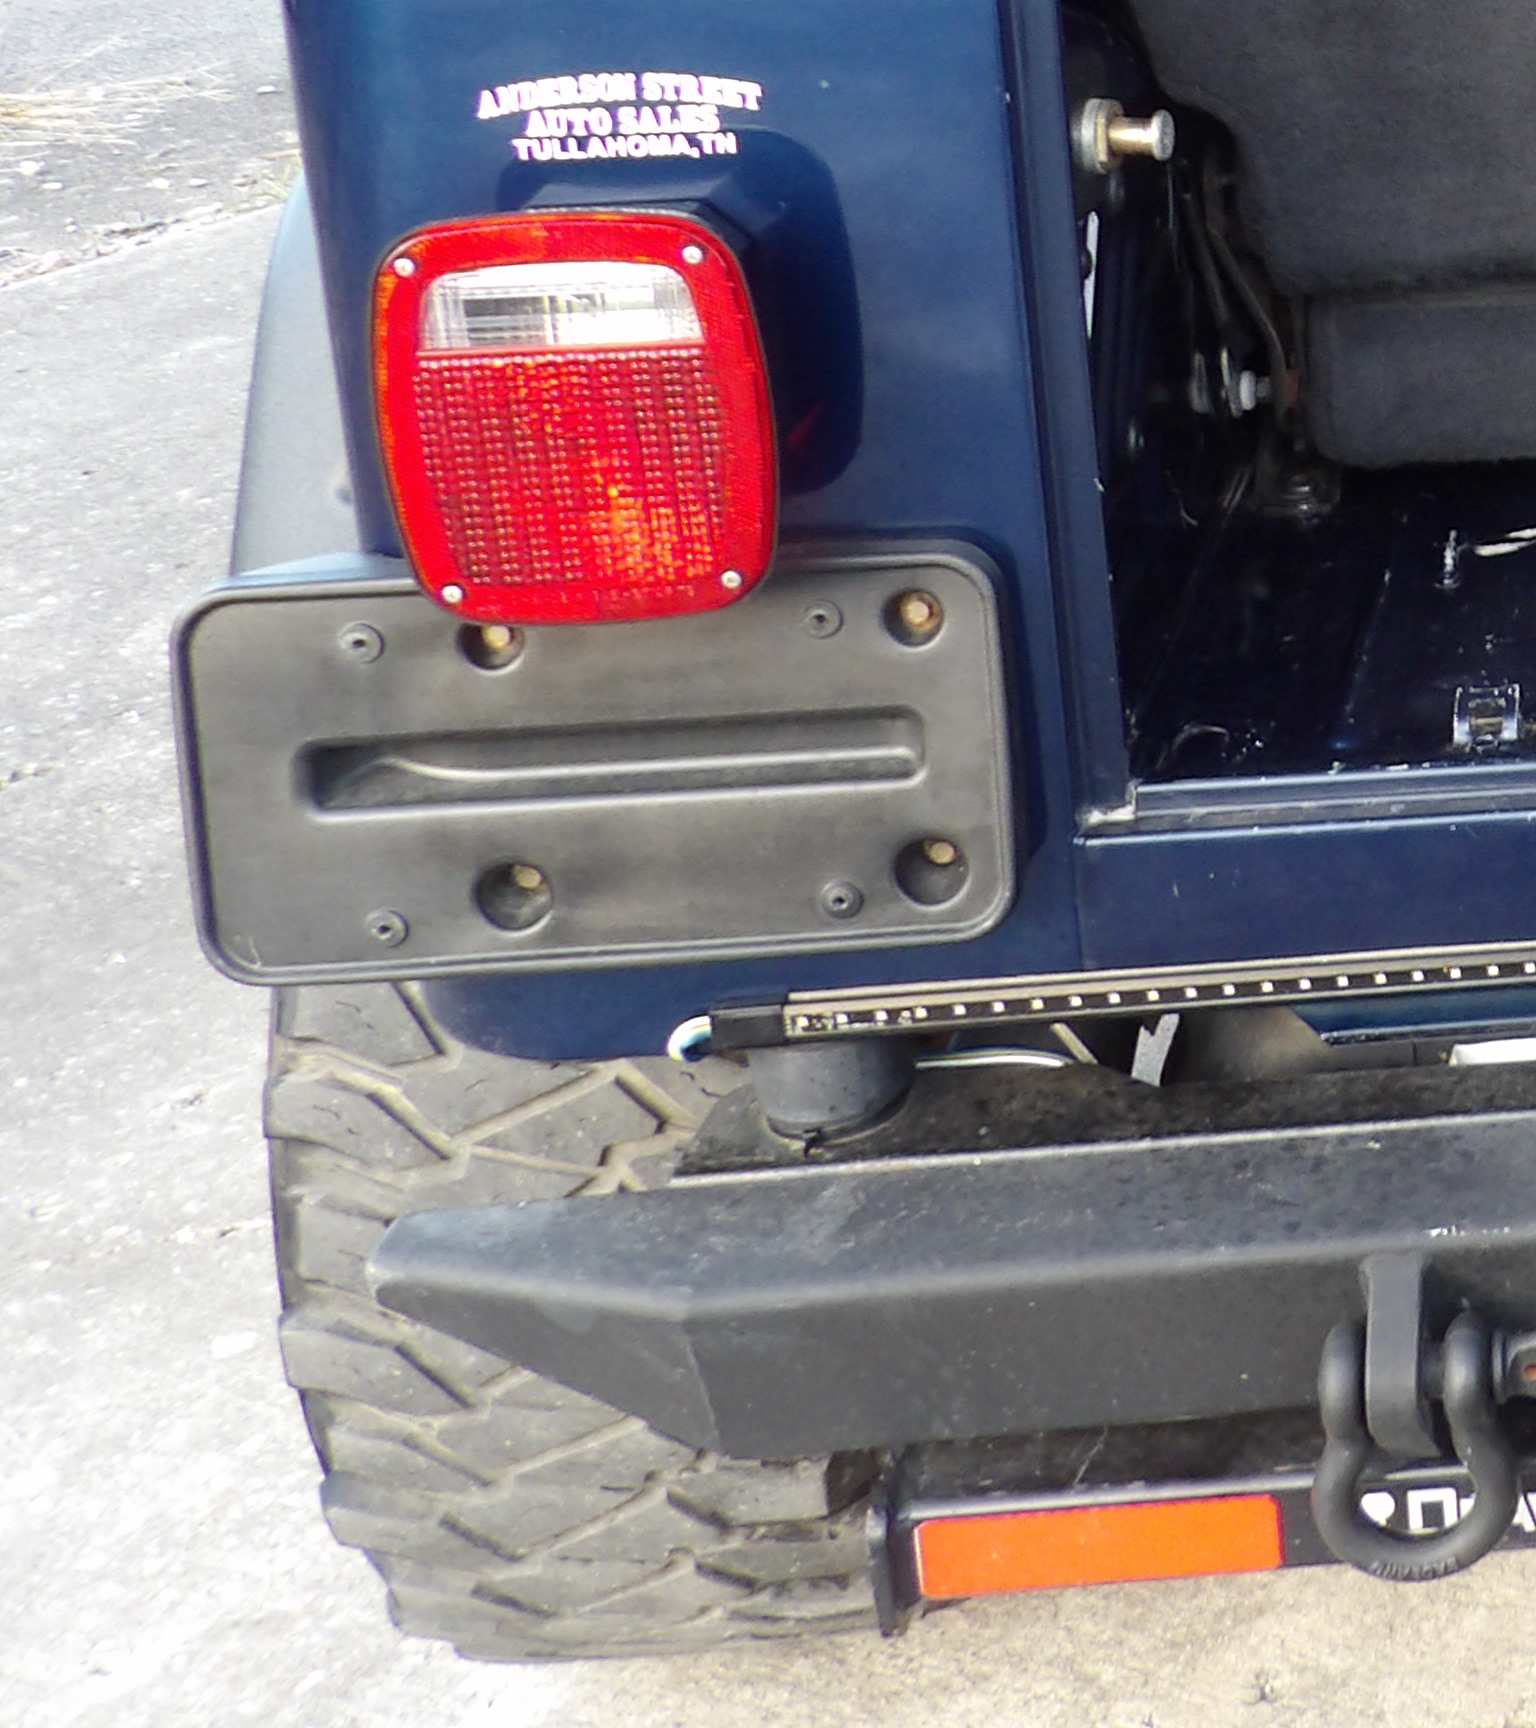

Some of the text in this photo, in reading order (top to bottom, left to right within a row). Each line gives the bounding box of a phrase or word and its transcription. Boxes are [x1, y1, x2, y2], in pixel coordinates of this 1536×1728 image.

[477, 71, 763, 119] ANDERSON STREET
[525, 103, 720, 138] AUTO SALES
[511, 131, 739, 161] TULLAHOMA, TN
